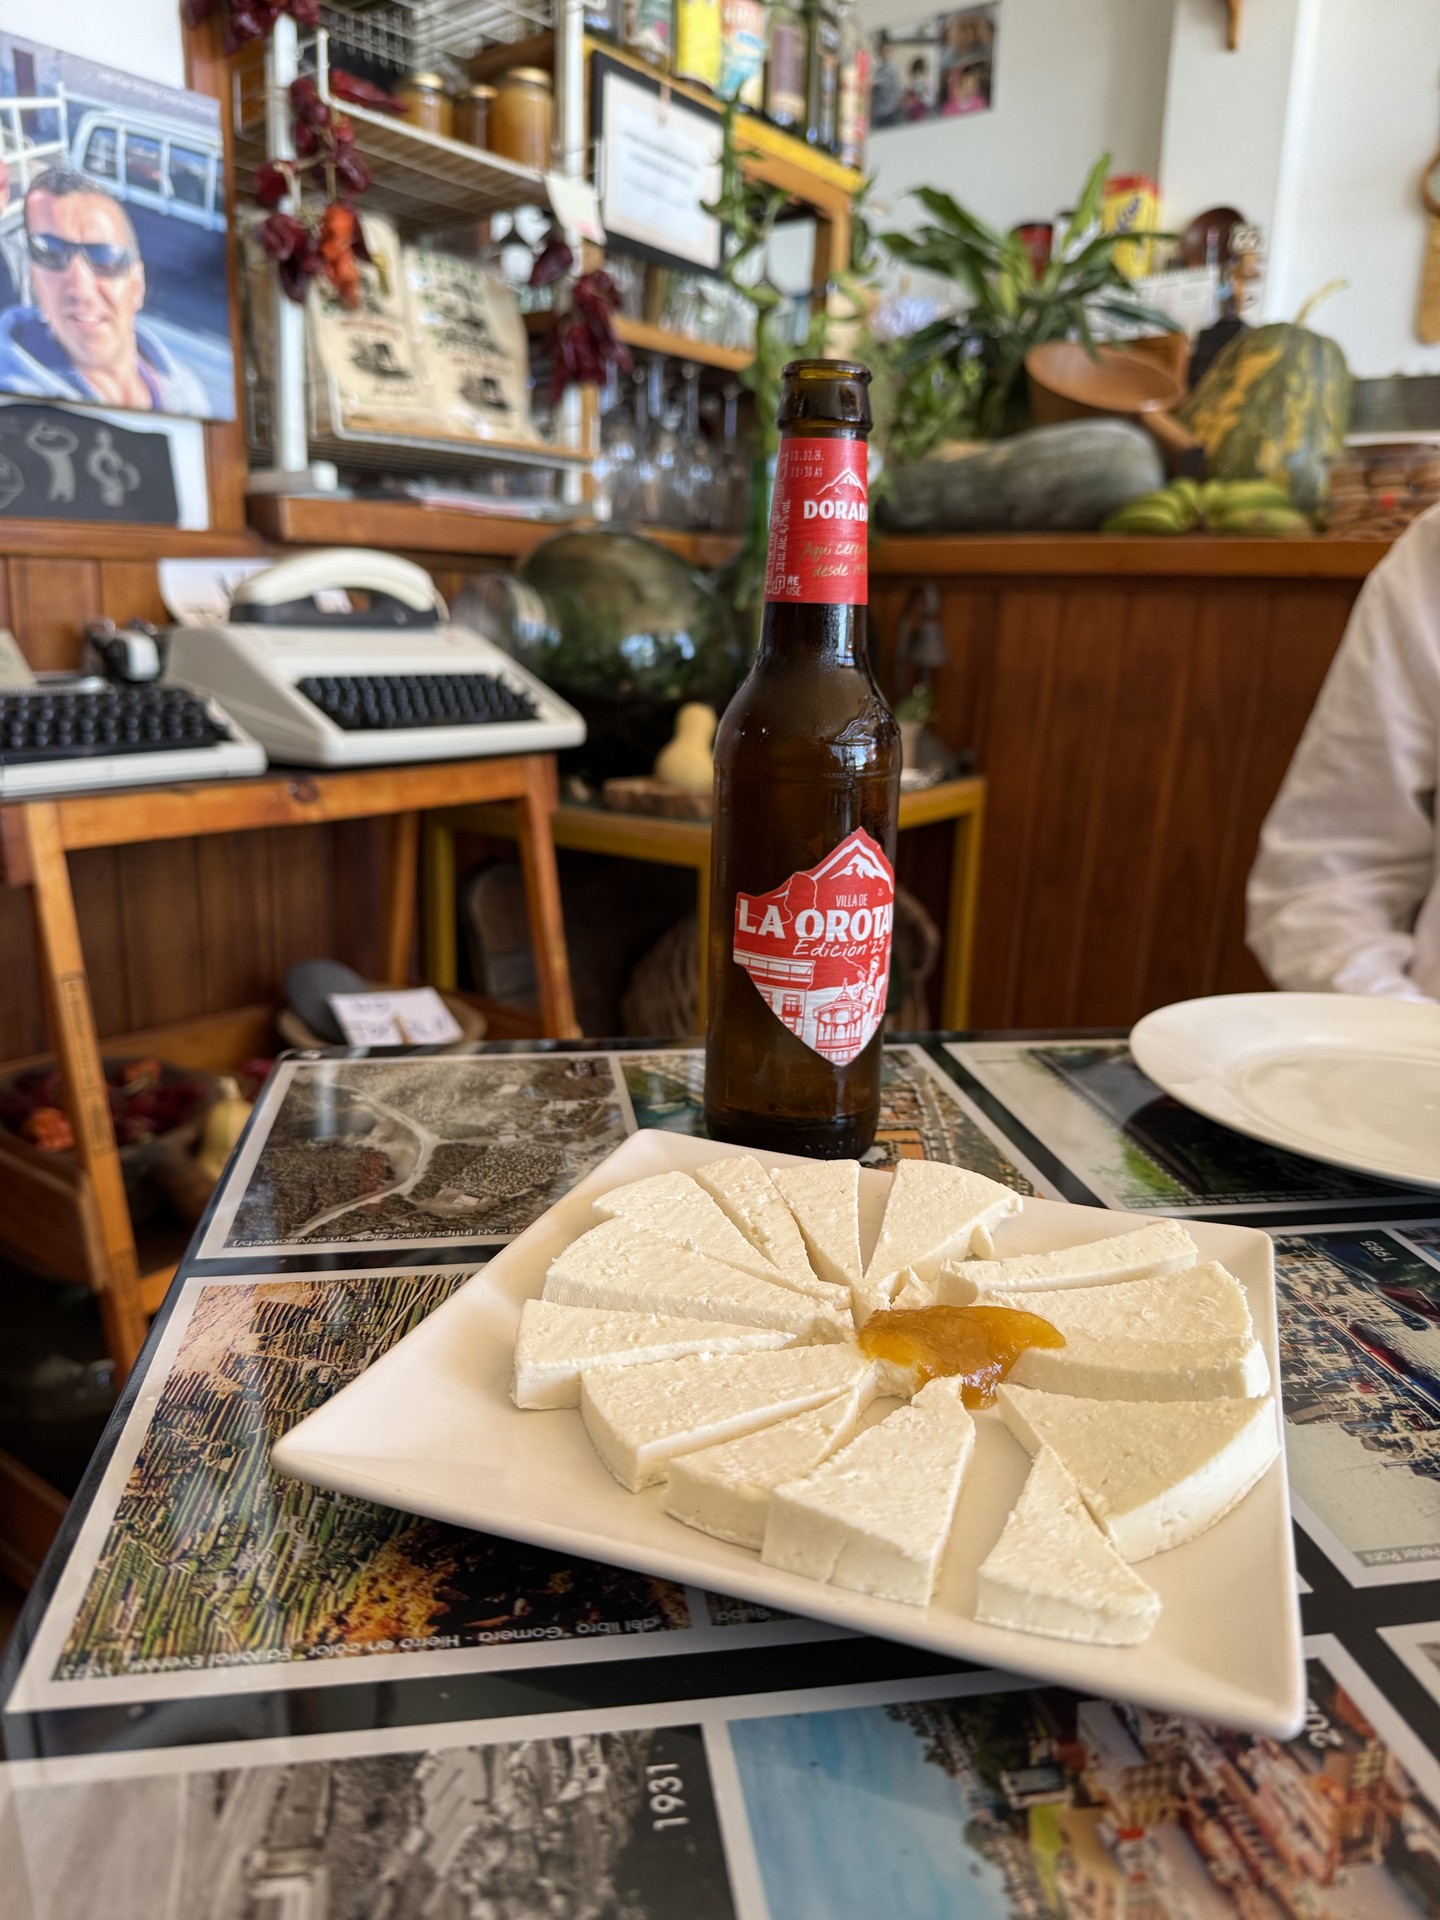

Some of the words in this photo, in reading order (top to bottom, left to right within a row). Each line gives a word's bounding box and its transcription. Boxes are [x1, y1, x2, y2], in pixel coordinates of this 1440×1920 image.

[812, 563, 848, 577] desde
[787, 575, 800, 586] RE
[786, 586, 802, 597] USE
[836, 895, 857, 907] VILLA
[858, 893, 868, 906] DE
[737, 898, 786, 939] LA
[477, 1226, 525, 1237] AFCAN
[1360, 1240, 1398, 1261] 1985
[576, 1621, 621, 1635] libro
[625, 1618, 657, 1633] del
[368, 1639, 395, 1651] en
[400, 1634, 459, 1649] Hierro
[645, 1763, 690, 1831] 1931
